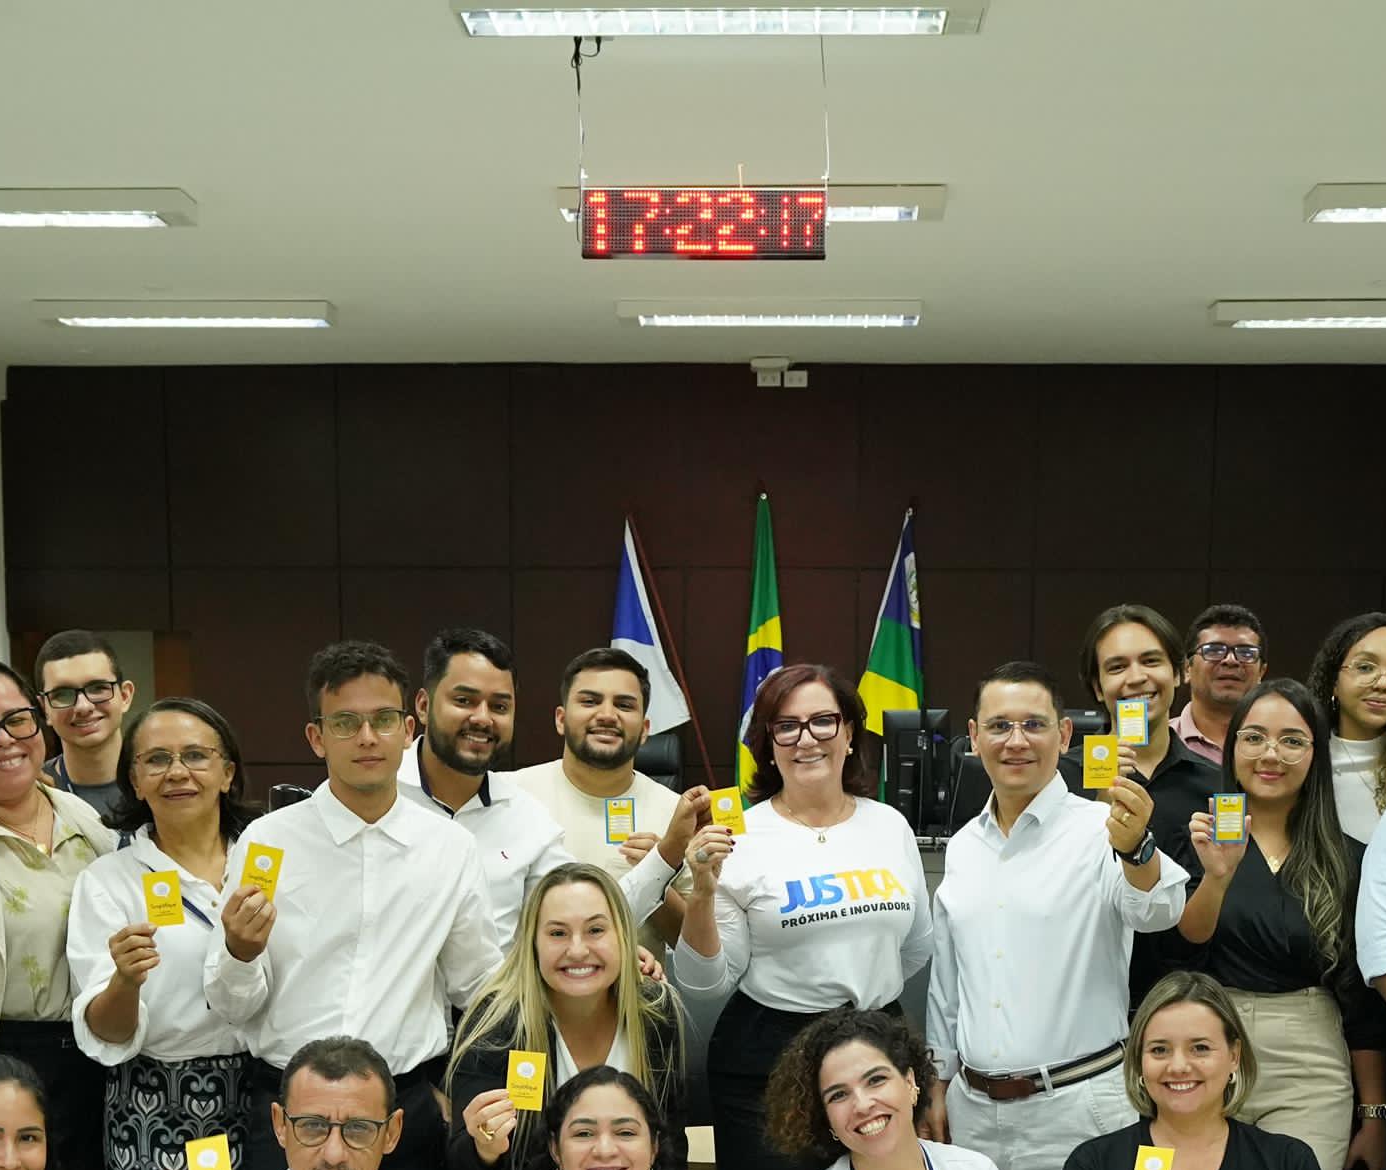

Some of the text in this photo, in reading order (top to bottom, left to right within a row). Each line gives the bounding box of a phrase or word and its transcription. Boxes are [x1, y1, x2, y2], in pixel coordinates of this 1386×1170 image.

[589, 191, 823, 251] 17:22:17
[780, 868, 908, 914] JUSTIÇA
[781, 902, 911, 928] PRÓXIMA E INOVADORA
